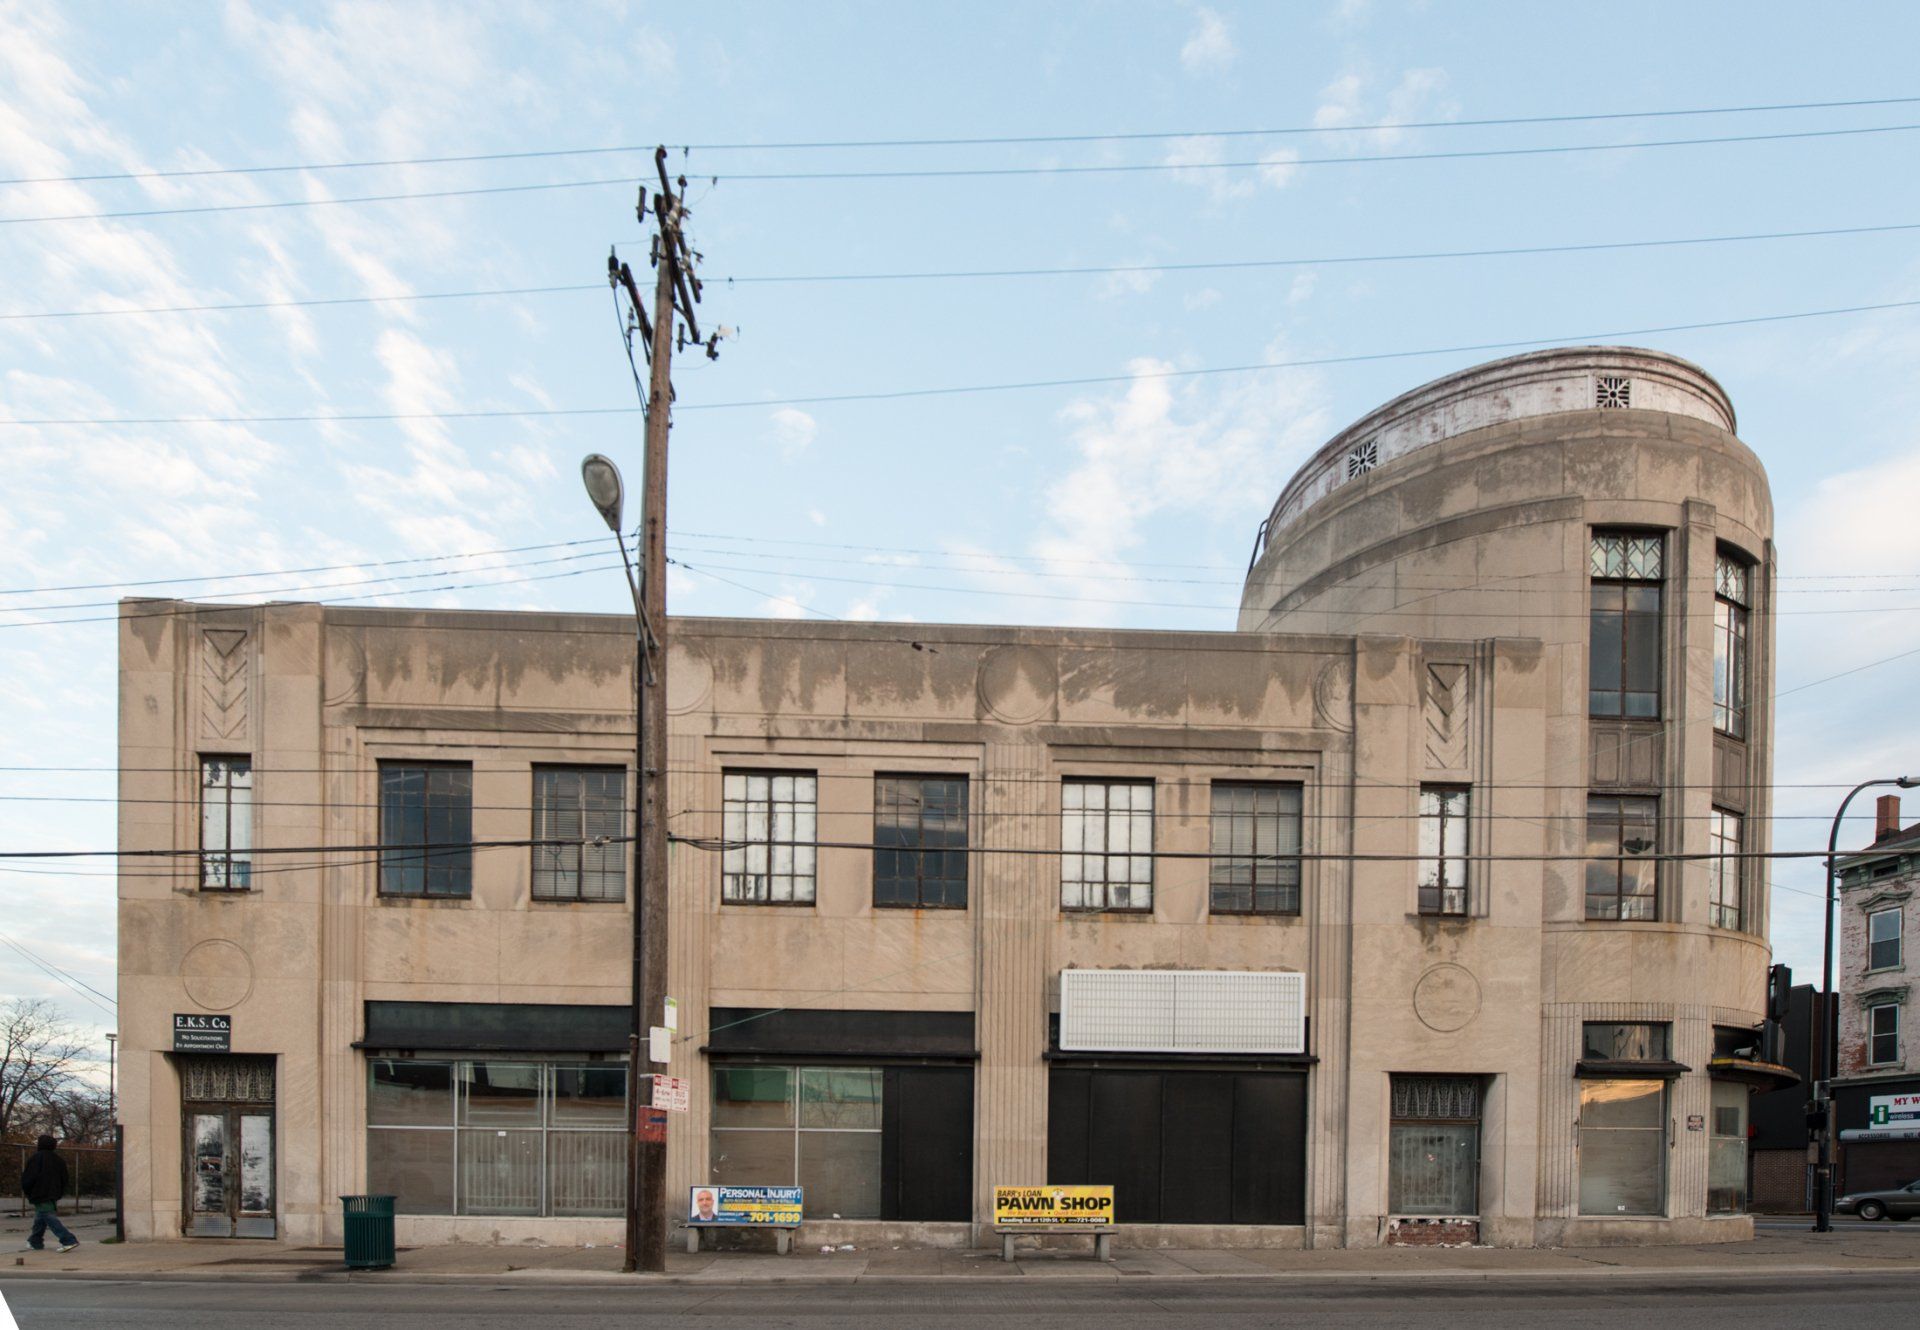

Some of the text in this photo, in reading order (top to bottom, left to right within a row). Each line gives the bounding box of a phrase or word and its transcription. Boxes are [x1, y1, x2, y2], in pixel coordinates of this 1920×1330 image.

[176, 1016, 230, 1029] E.K.S. Co.
[1894, 1097, 1908, 1106] MY
[719, 1187, 801, 1199] PERSONAL INJURY?
[997, 1190, 1042, 1198] BARR's LOAN
[997, 1197, 1111, 1211] PAWN SHOP
